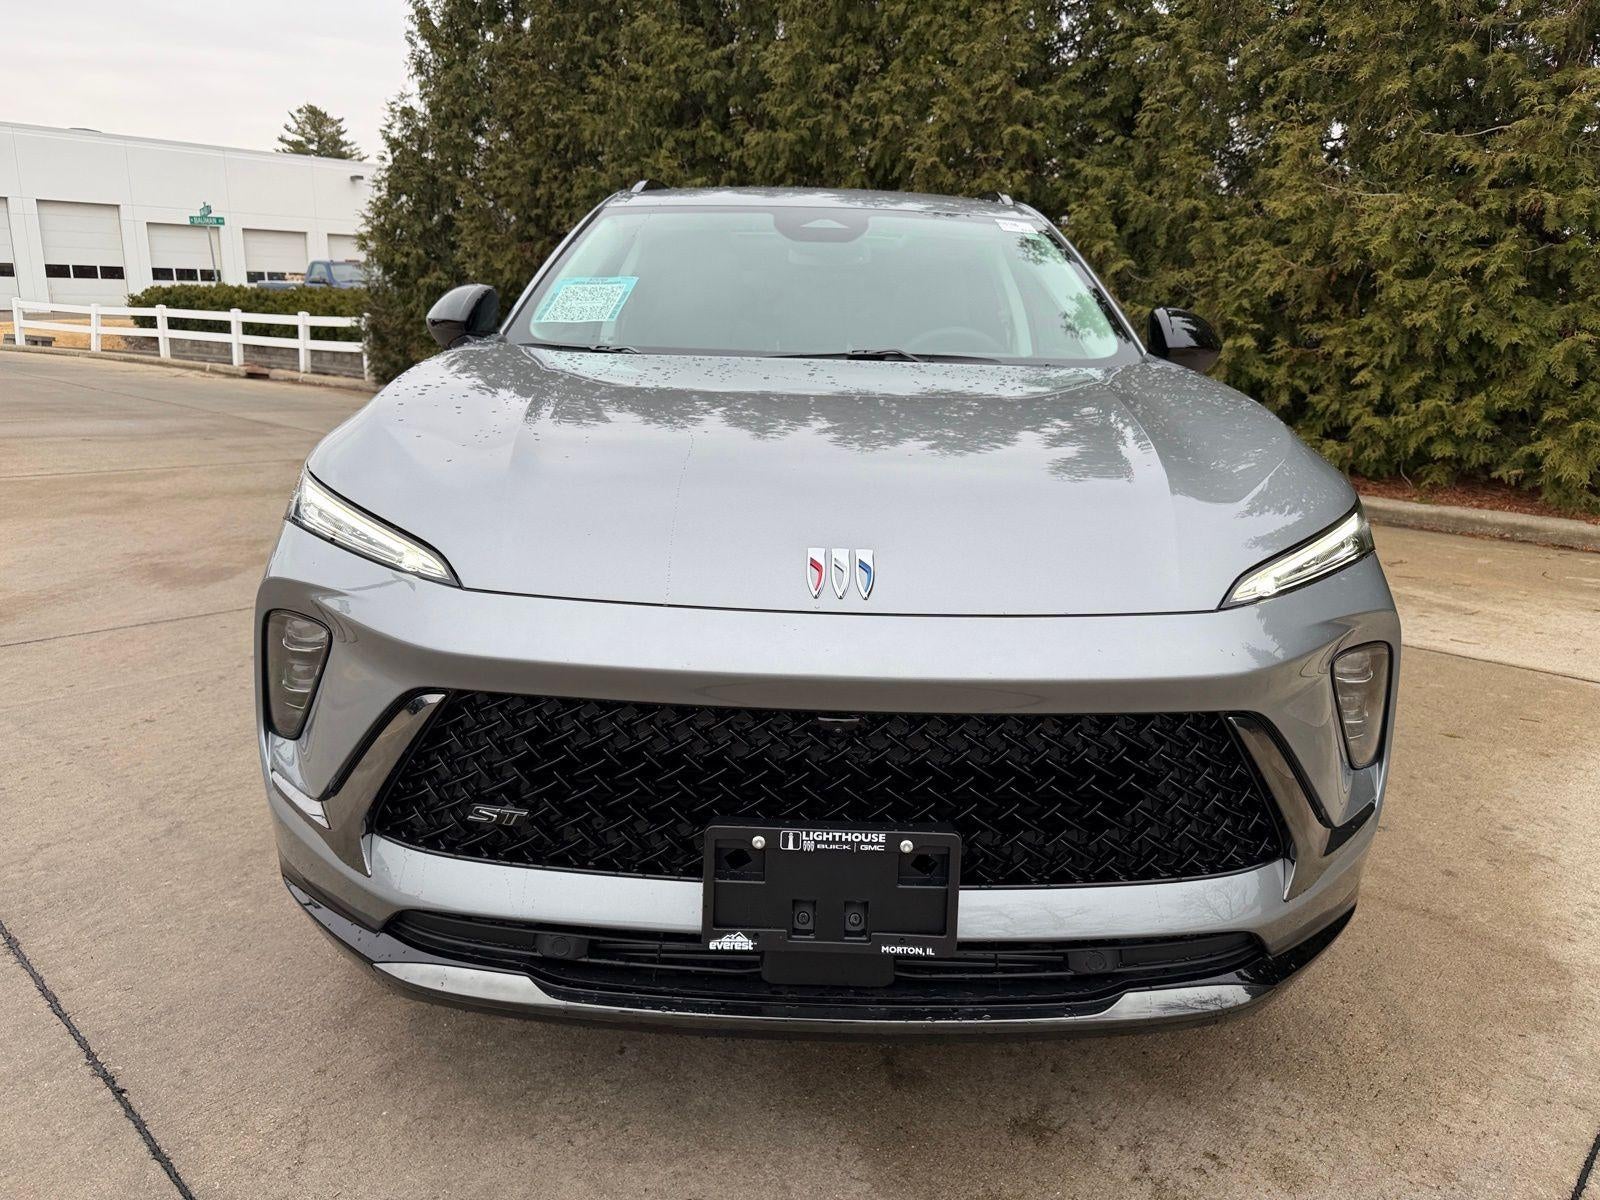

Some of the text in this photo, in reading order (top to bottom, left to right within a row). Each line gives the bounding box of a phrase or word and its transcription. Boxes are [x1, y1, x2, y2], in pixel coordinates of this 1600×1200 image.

[466, 805, 528, 825] ST
[802, 831, 886, 843] LIGHTHOUSE
[709, 939, 755, 950] everest
[881, 945, 935, 956] MORTON, IL
